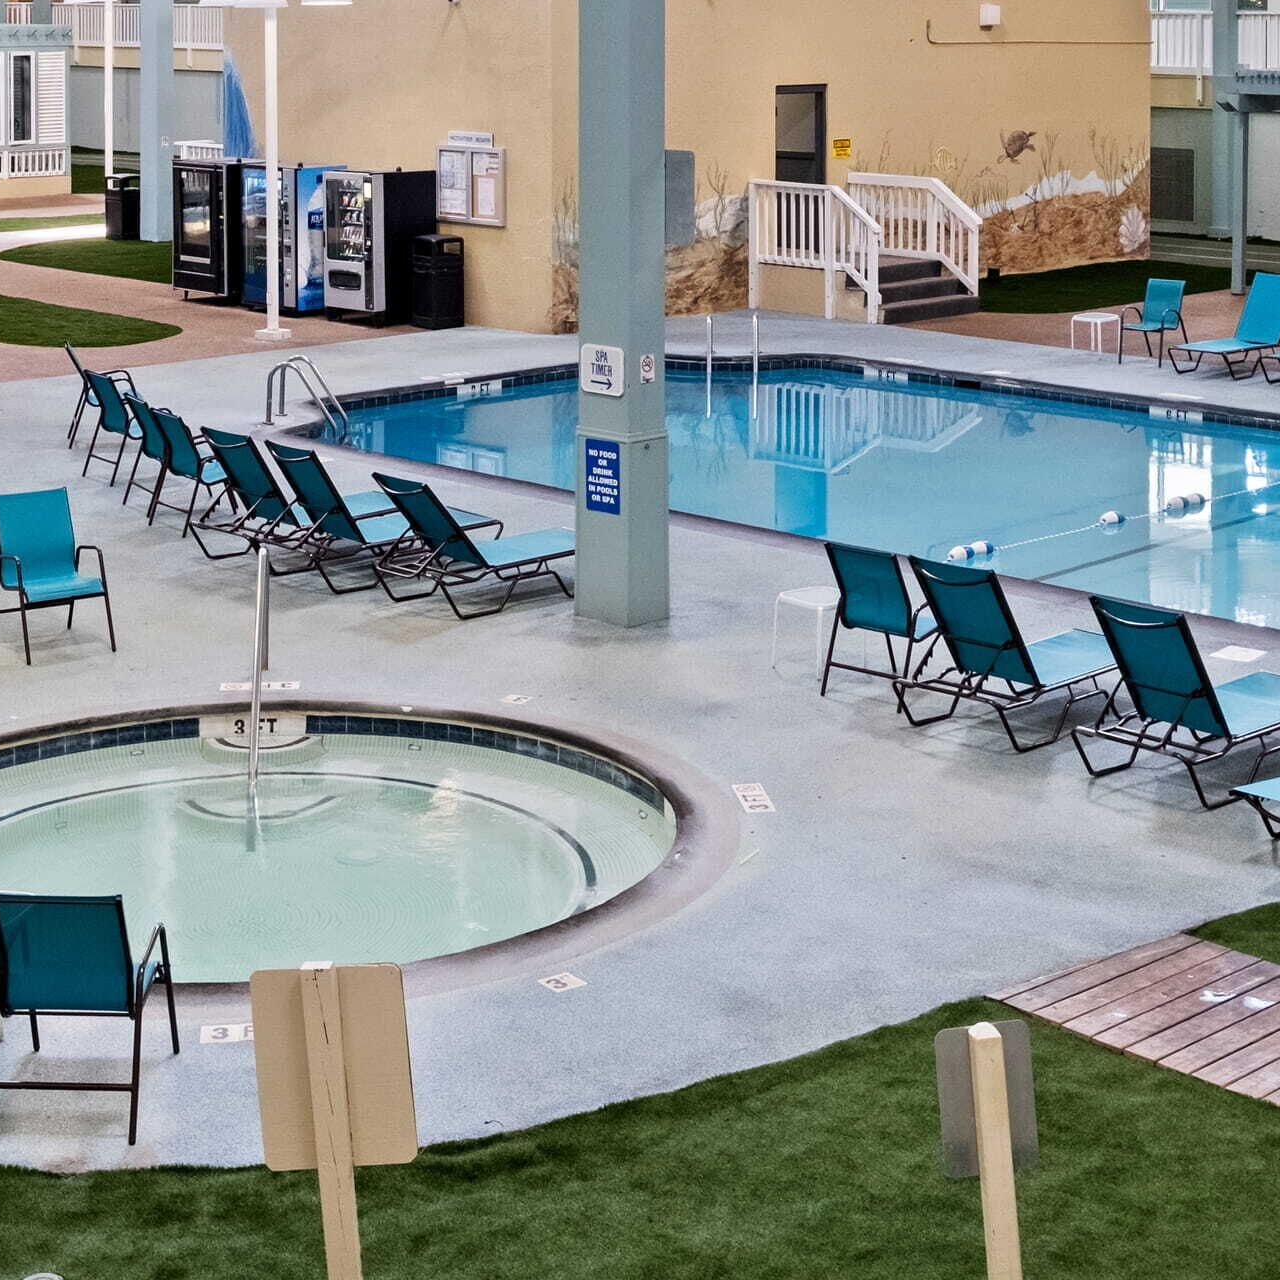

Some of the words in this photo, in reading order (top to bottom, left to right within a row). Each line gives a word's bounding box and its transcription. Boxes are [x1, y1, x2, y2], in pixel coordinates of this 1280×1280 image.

[595, 350, 608, 364] SPA
[592, 363, 612, 377] TIMER
[589, 449, 598, 457] NO
[599, 450, 617, 459] FOOD
[598, 459, 608, 467] OR
[592, 467, 613, 477] DRINK
[588, 475, 618, 486] ALLOWED
[588, 484, 596, 492] IN
[597, 486, 618, 496] POOLS
[591, 494, 601, 502] OR
[602, 496, 615, 504] SPA
[234, 719, 245, 734] 3
[211, 1027, 229, 1040] 3
